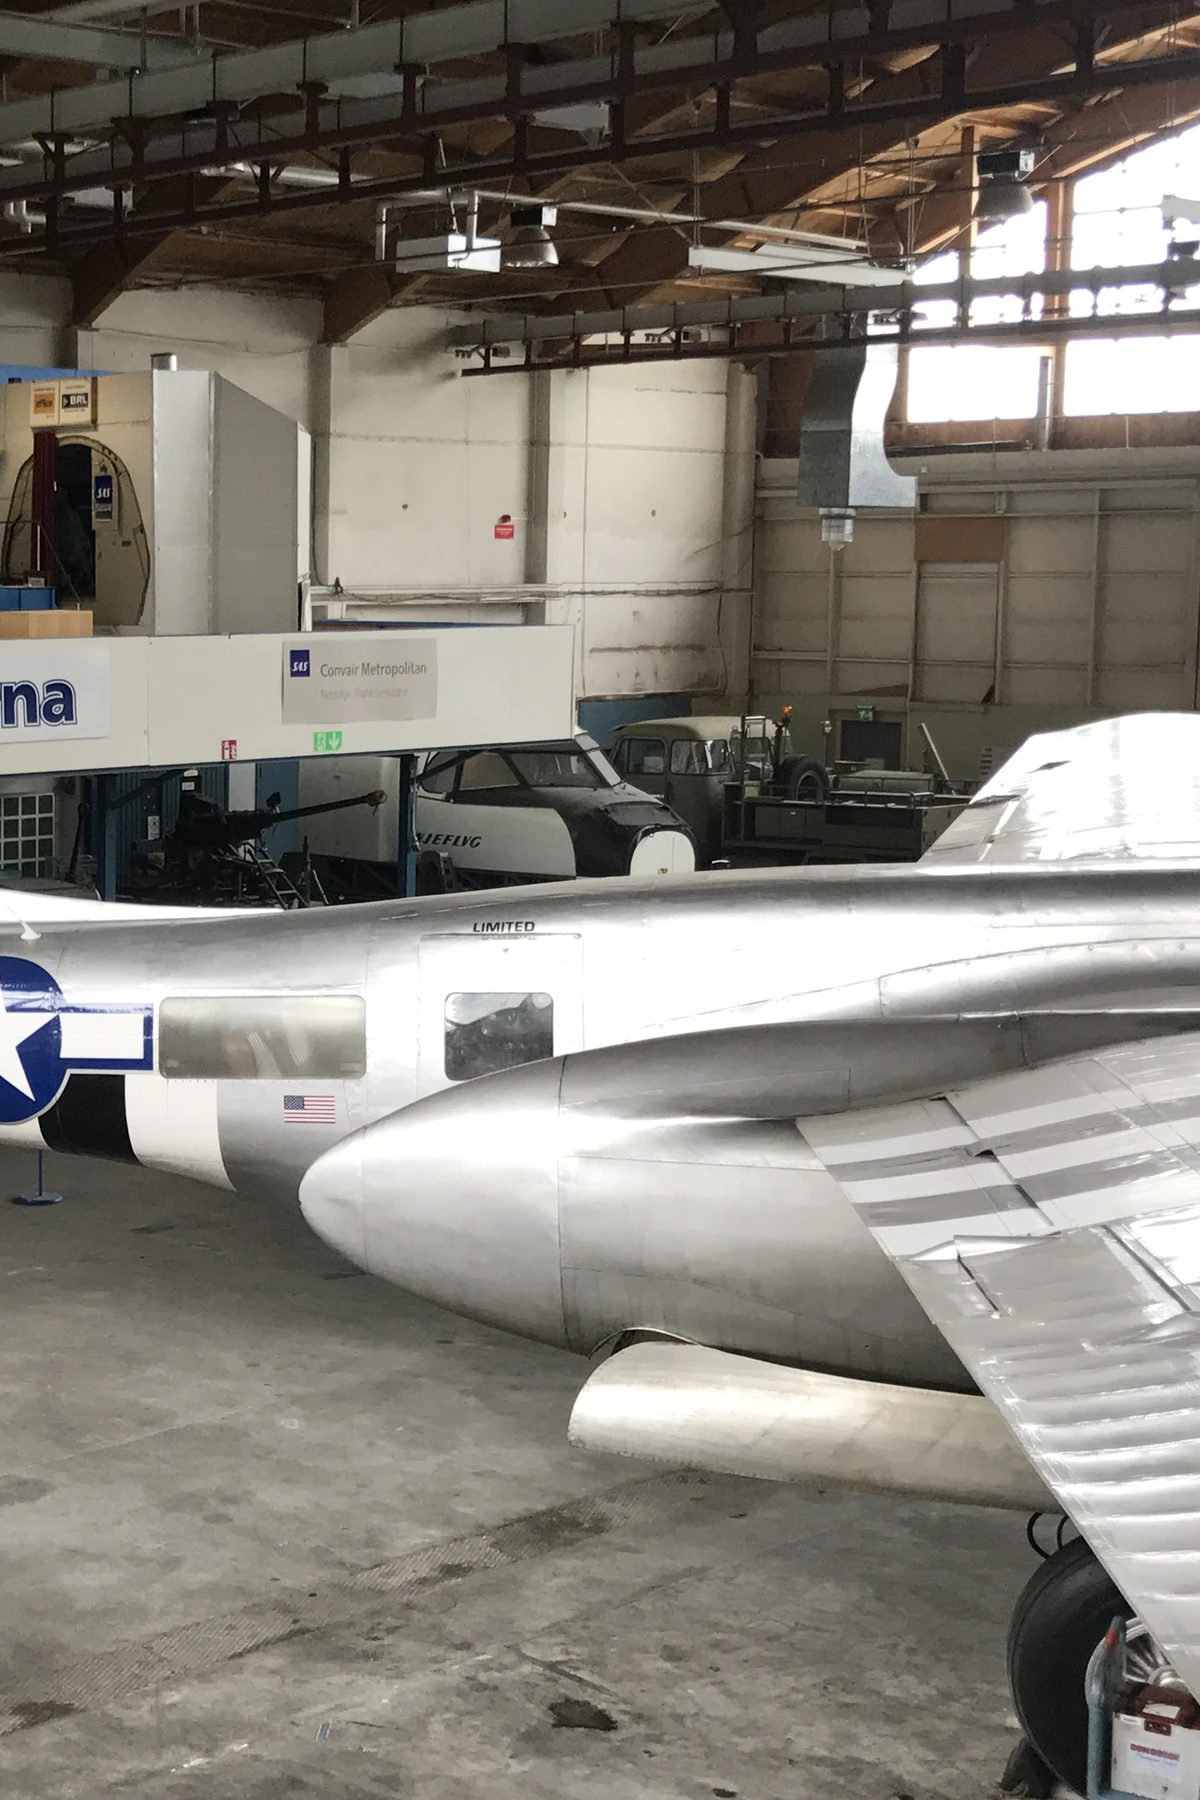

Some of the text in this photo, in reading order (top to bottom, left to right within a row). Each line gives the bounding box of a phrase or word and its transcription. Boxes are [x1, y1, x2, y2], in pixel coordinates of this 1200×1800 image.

[69, 395, 88, 405] BRL
[291, 661, 309, 672] SAS
[320, 661, 427, 678] Convair Metropolitan
[473, 921, 535, 932] LIMITED
